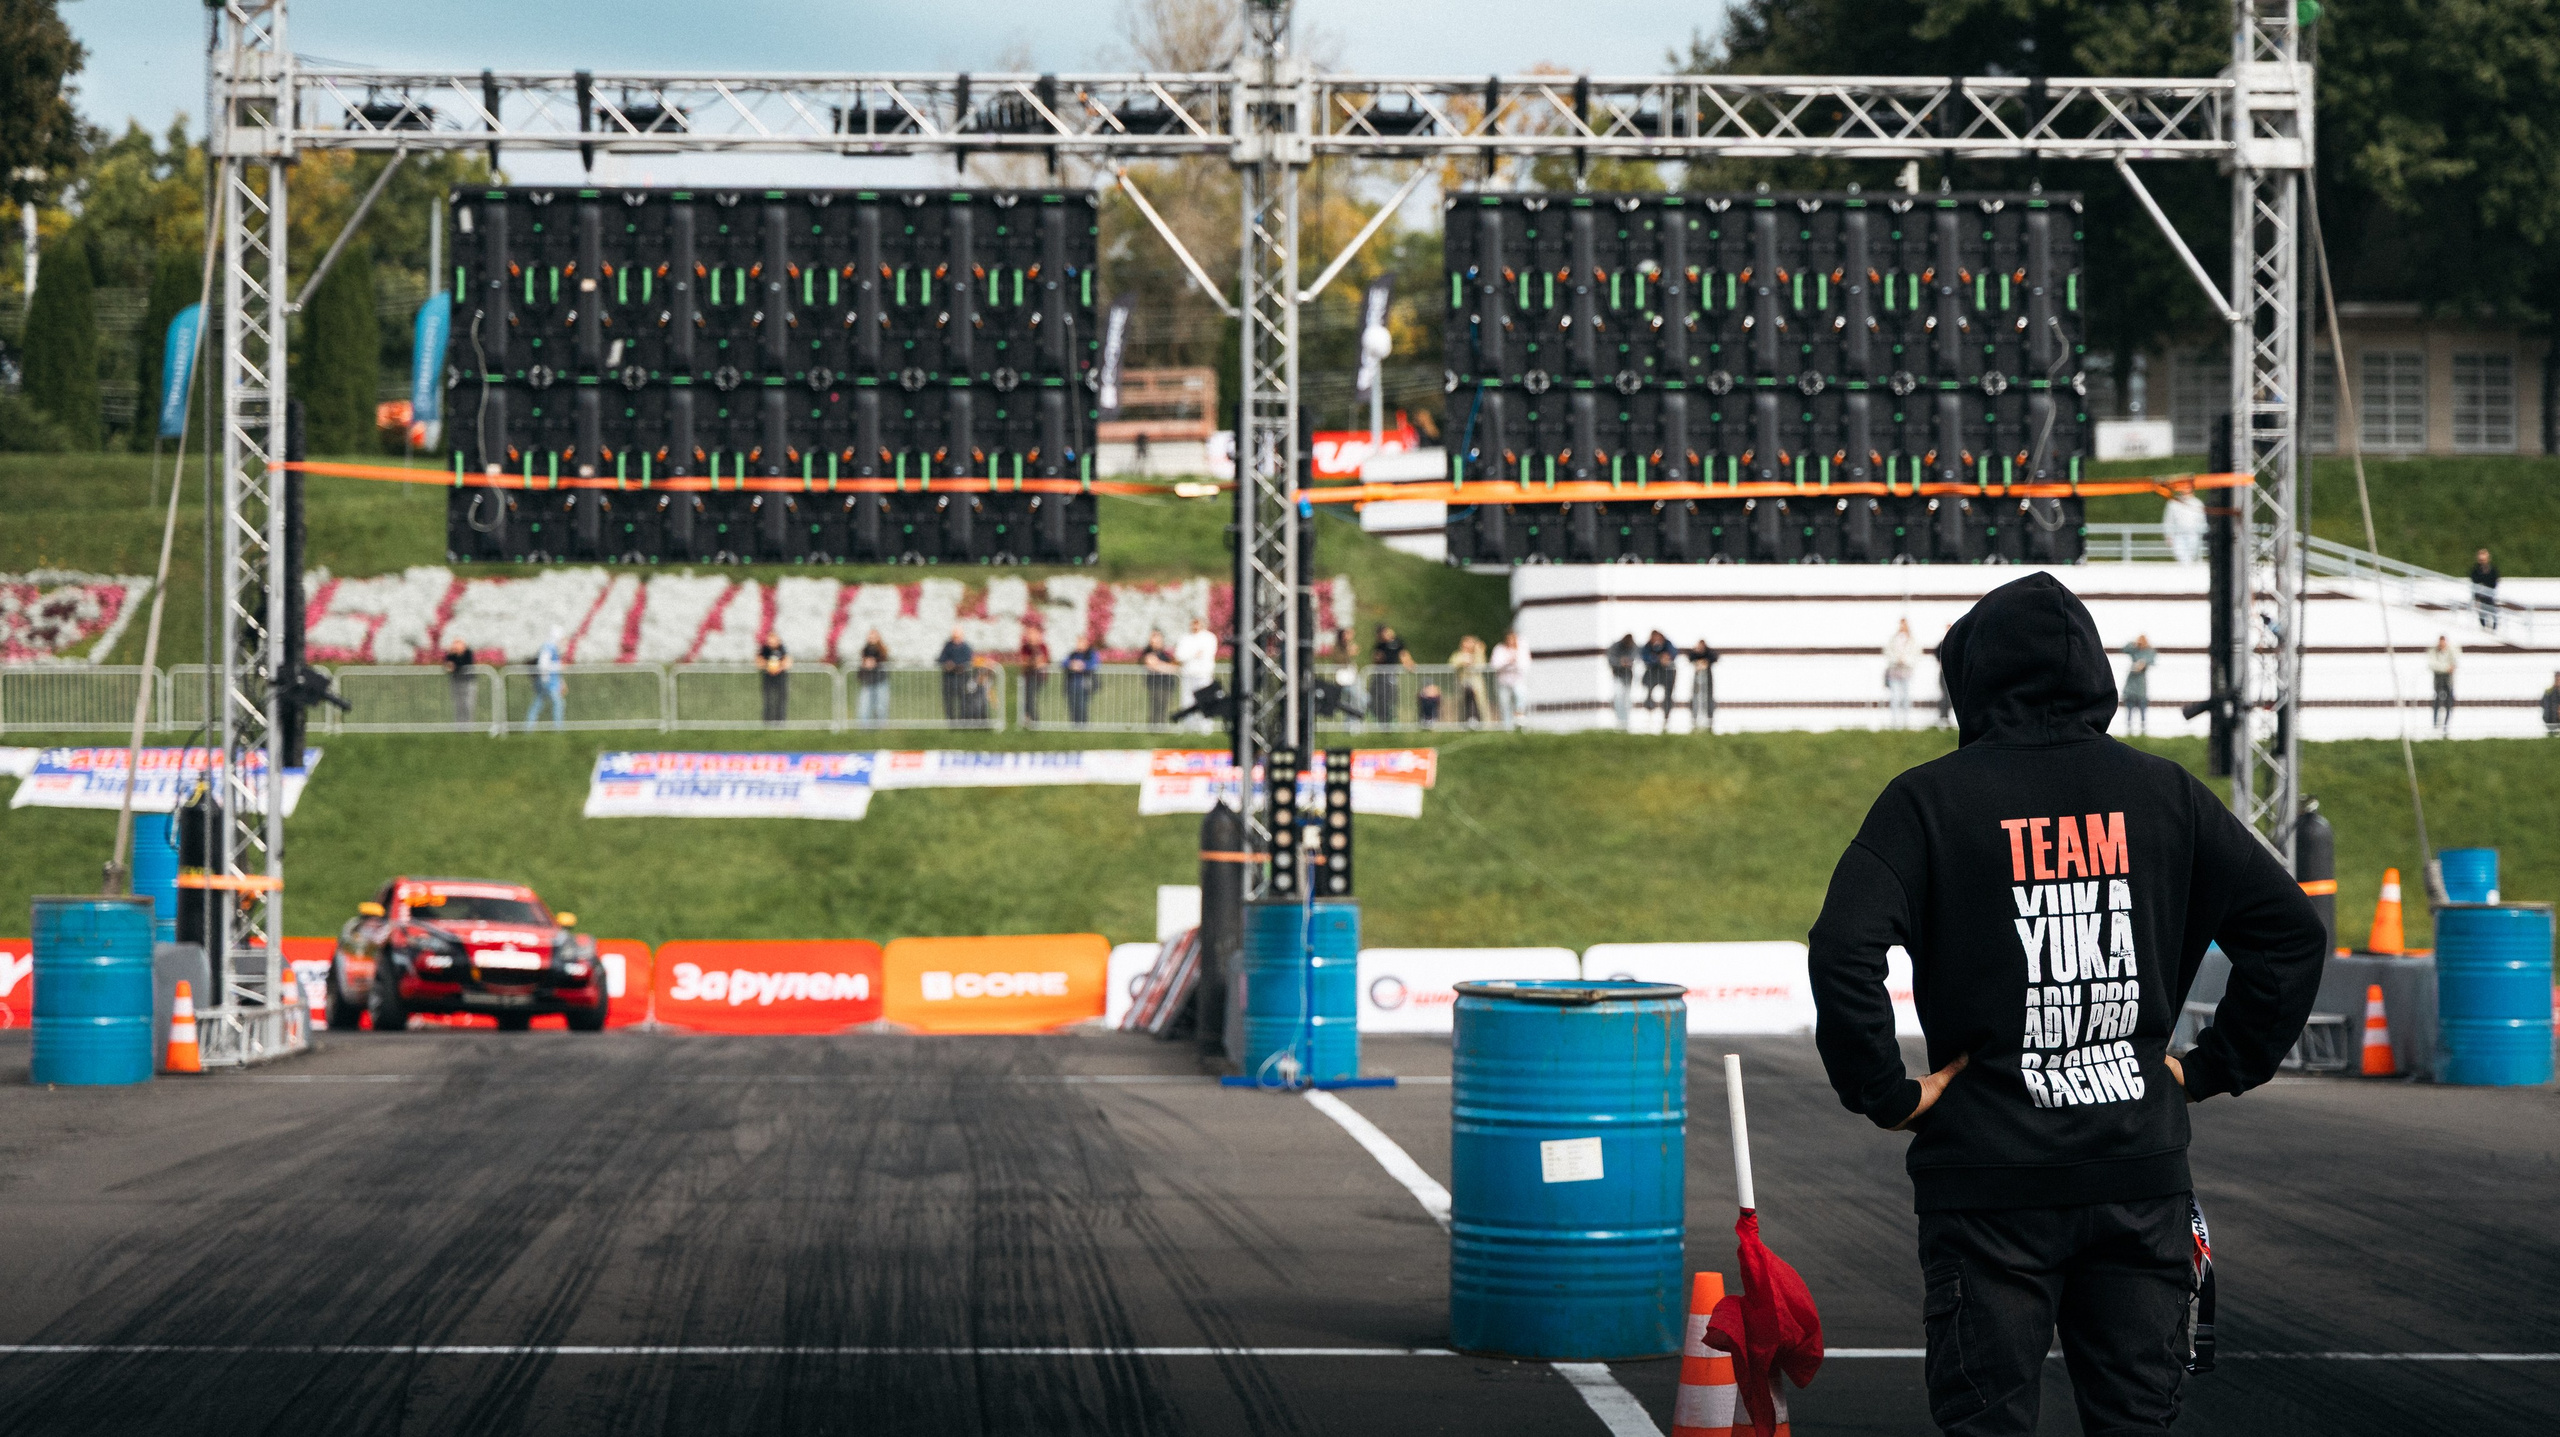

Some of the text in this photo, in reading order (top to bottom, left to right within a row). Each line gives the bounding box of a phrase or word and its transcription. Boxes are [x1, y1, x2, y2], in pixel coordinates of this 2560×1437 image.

[2000, 812, 2130, 881] TEAM
[2014, 911, 2138, 983] YUKA
[2023, 1001, 2139, 1049] ADV PRO
[2022, 1057, 2145, 1108] RACING
